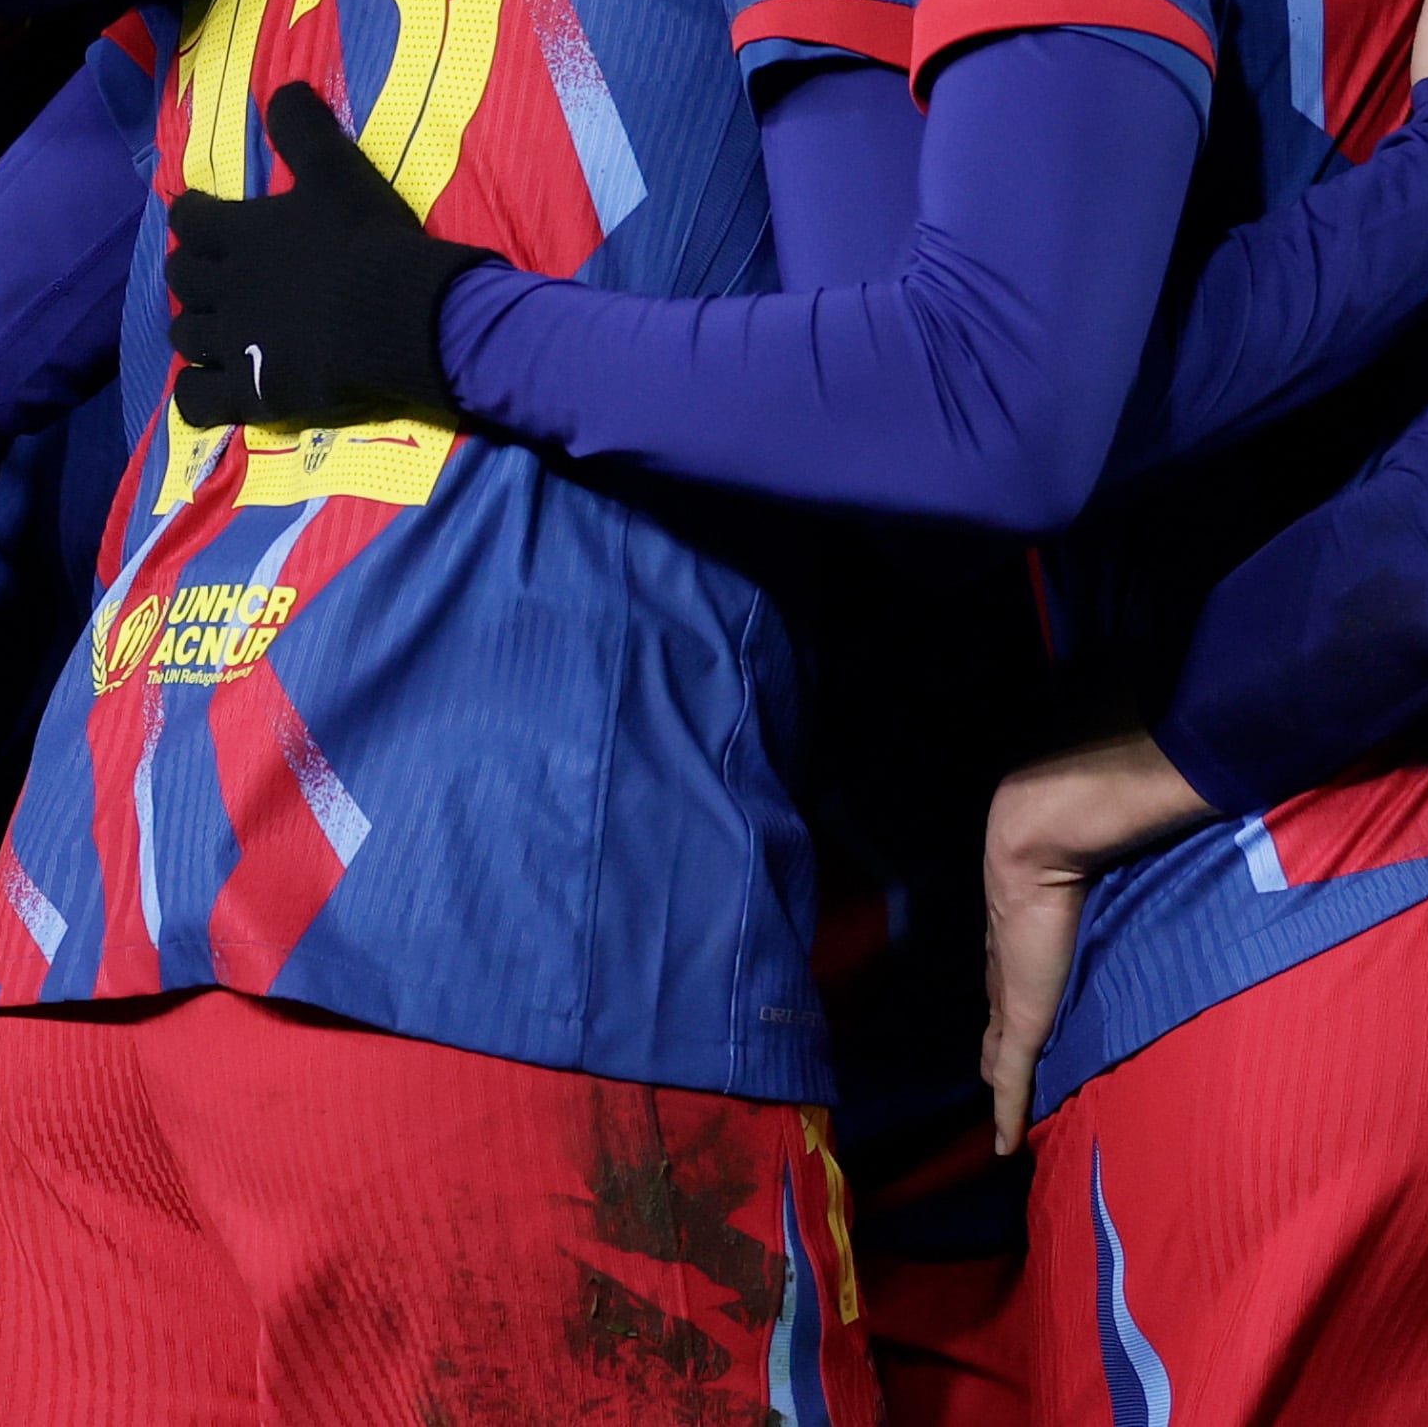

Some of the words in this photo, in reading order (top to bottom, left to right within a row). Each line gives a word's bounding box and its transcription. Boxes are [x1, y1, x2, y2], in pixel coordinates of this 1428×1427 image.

[168, 584, 298, 625] UNHCR
[148, 625, 278, 667] ACNUR
[146, 670, 165, 685] The
[164, 668, 180, 684] UN
[180, 668, 224, 688] Refugee
